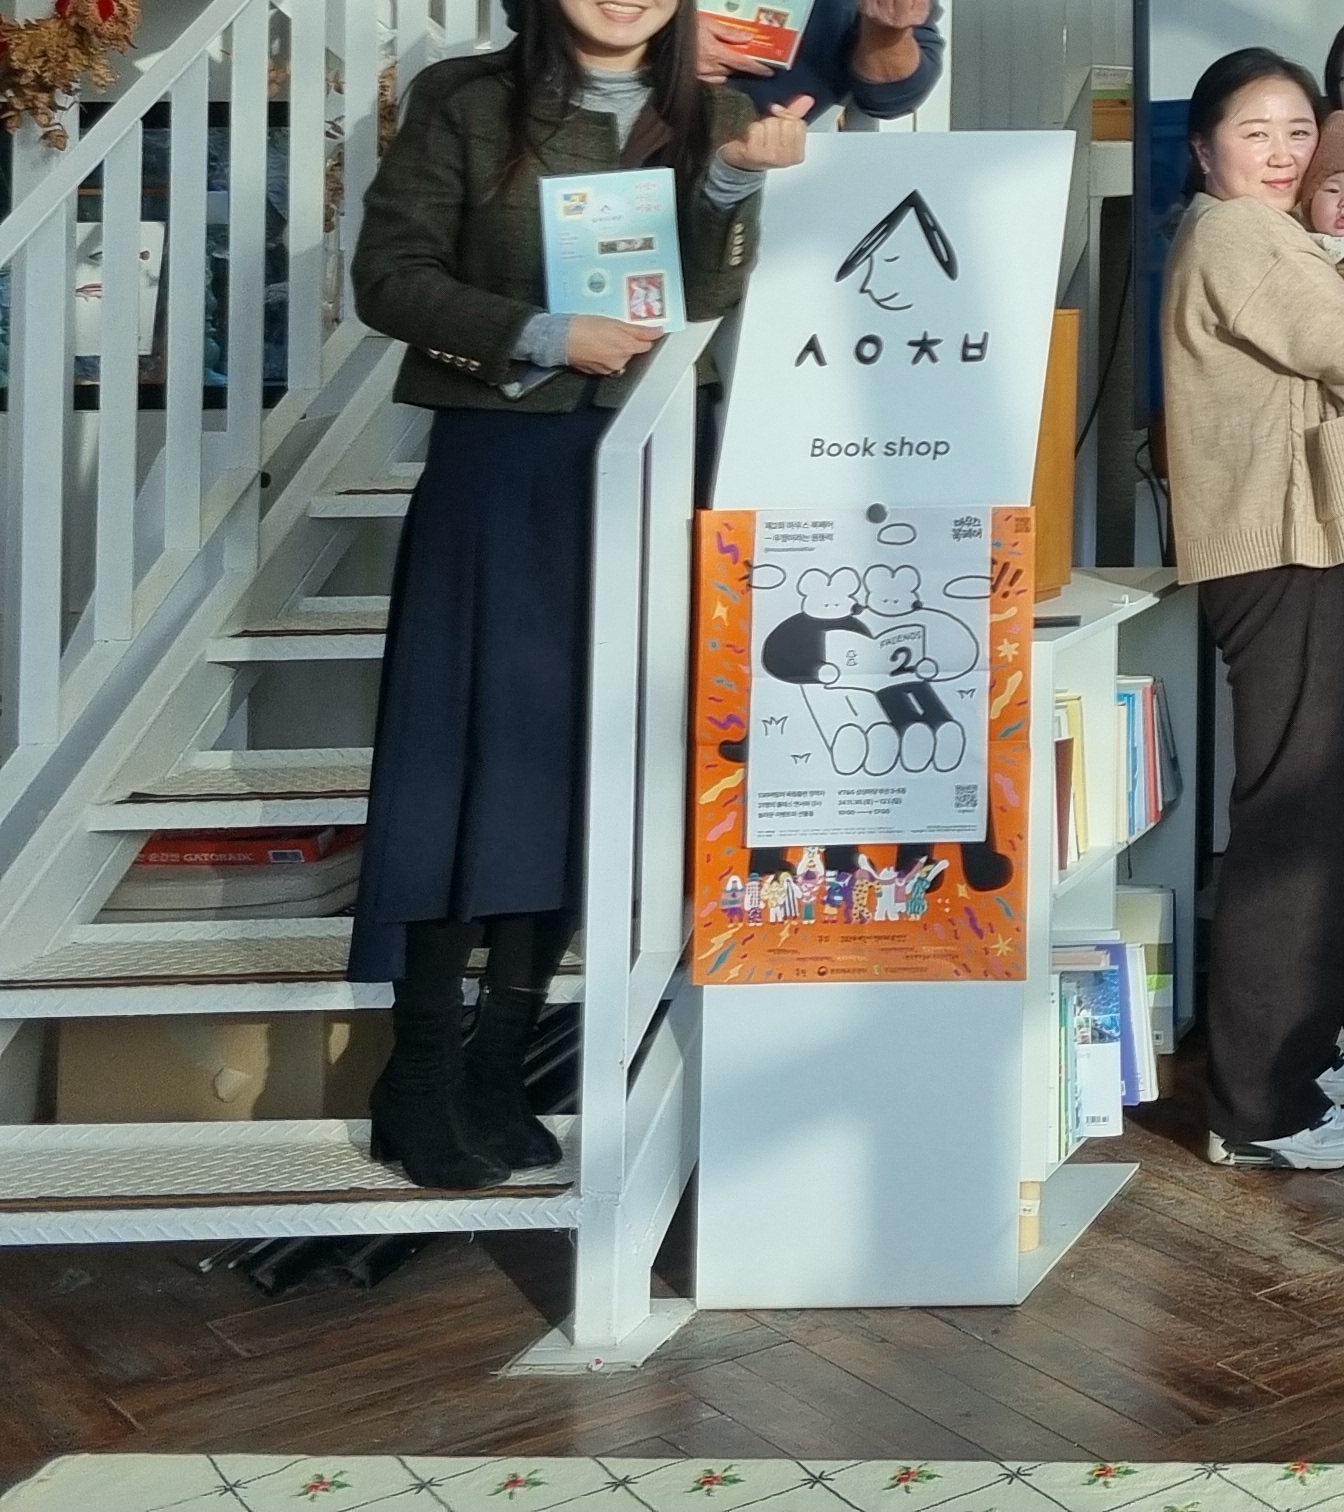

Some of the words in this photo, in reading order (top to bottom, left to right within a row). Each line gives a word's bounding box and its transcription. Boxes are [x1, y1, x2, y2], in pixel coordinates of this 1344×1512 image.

[810, 437, 877, 458] Book
[882, 436, 951, 461] shop
[879, 630, 923, 649] FRIENDS
[889, 645, 916, 678] 2
